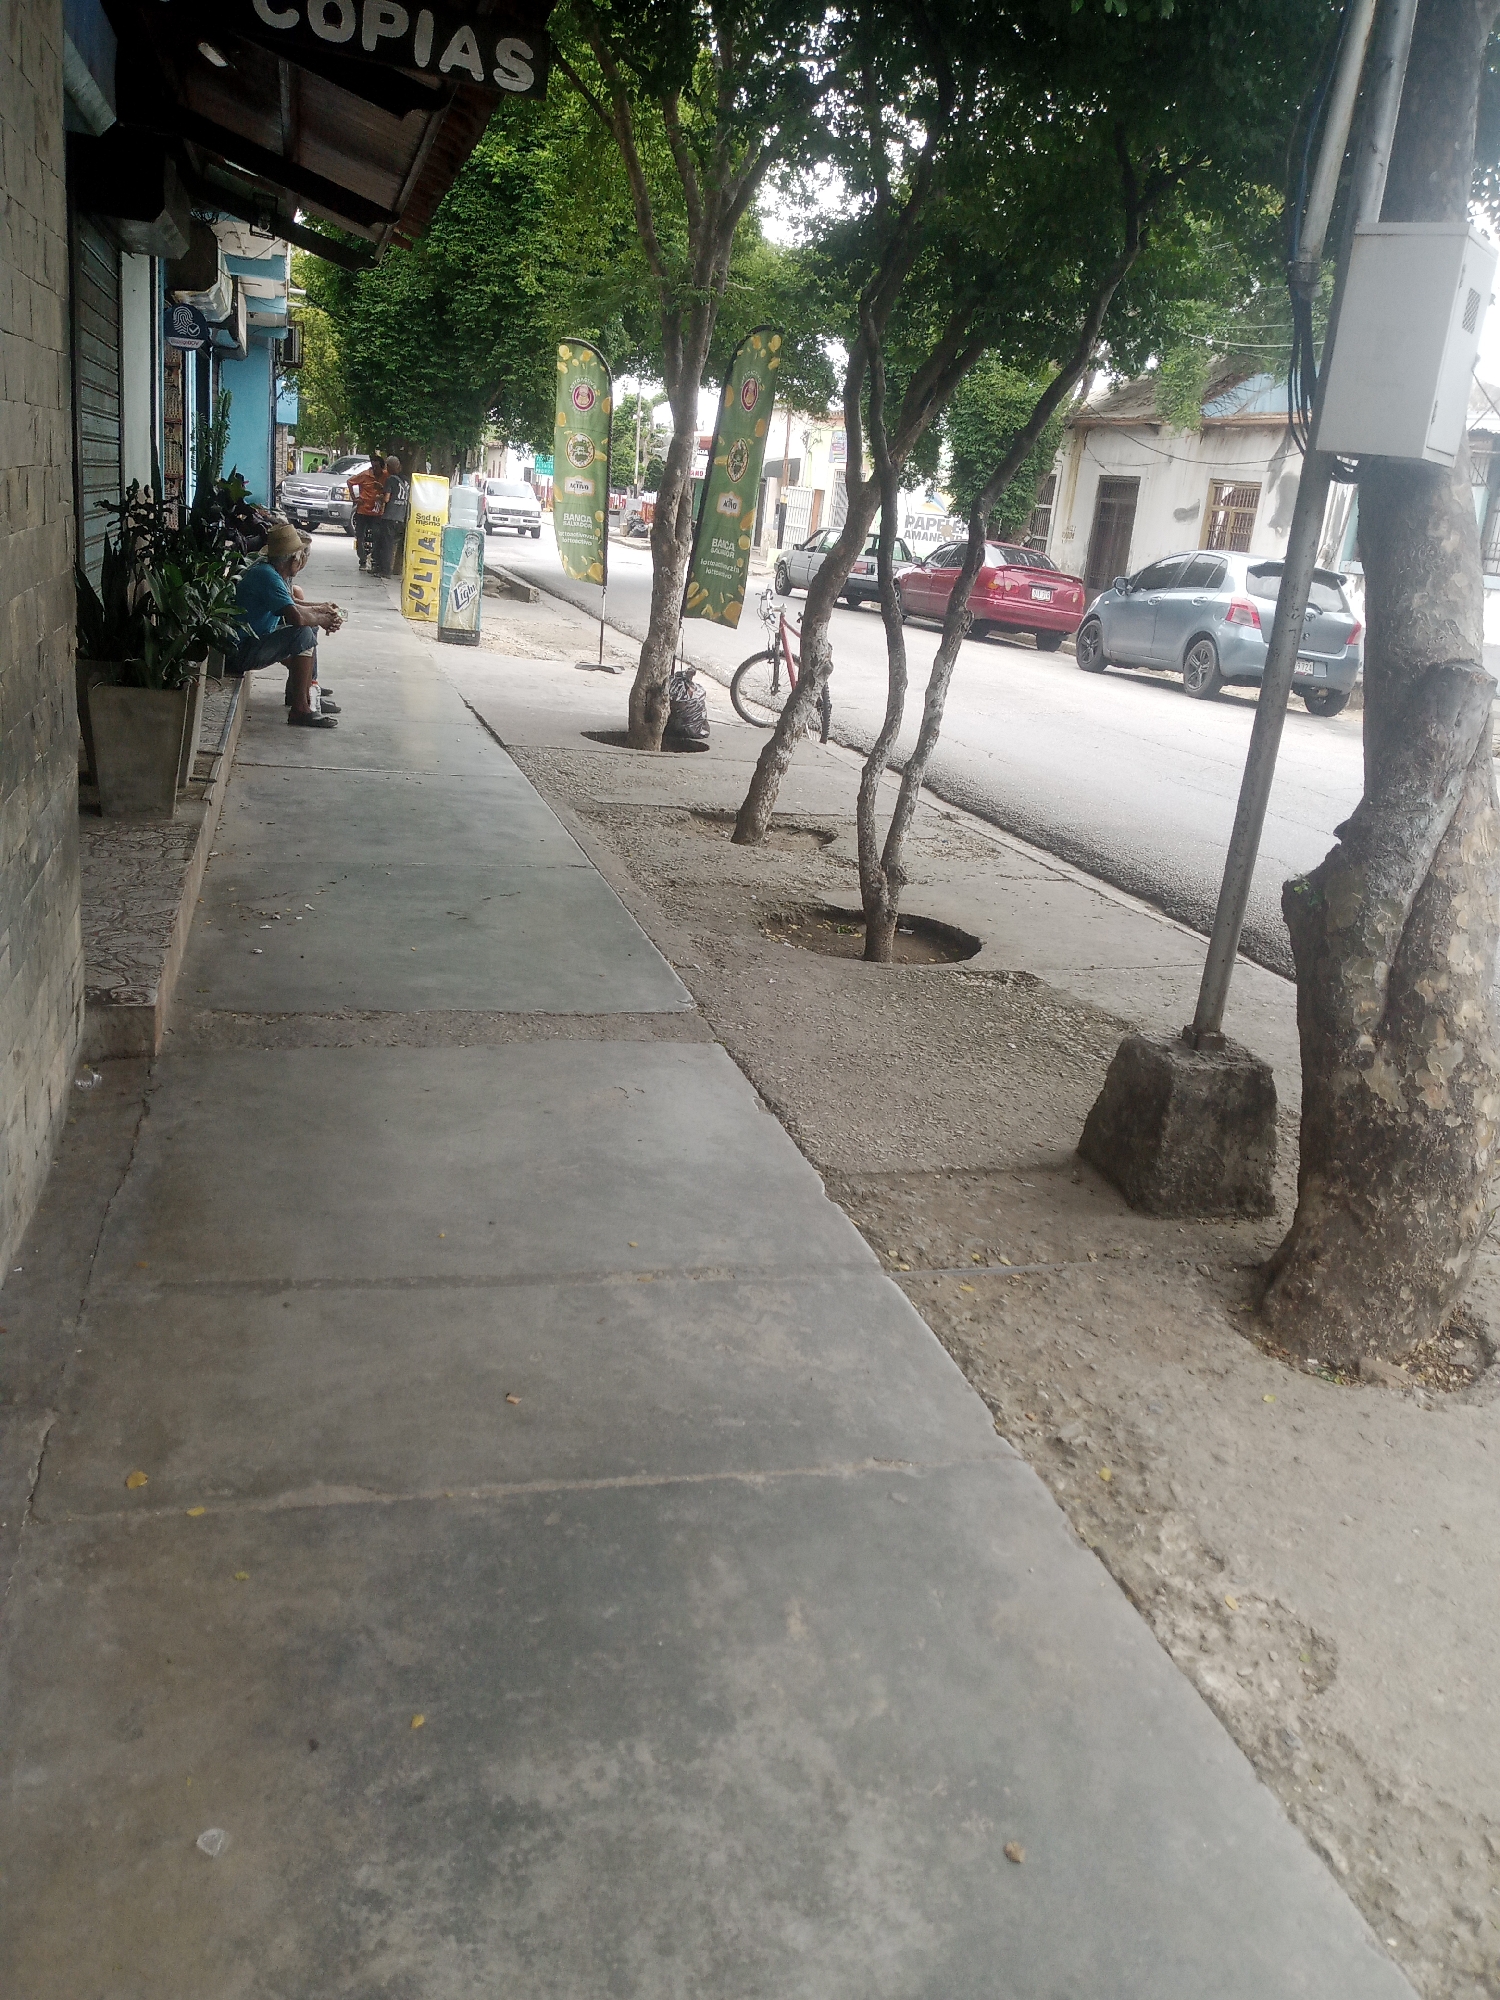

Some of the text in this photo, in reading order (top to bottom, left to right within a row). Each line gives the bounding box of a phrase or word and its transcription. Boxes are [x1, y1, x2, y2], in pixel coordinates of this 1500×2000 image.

[252, 0, 534, 92] COPIAS
[563, 512, 593, 524] BANCA
[408, 536, 439, 616] ZULIA
